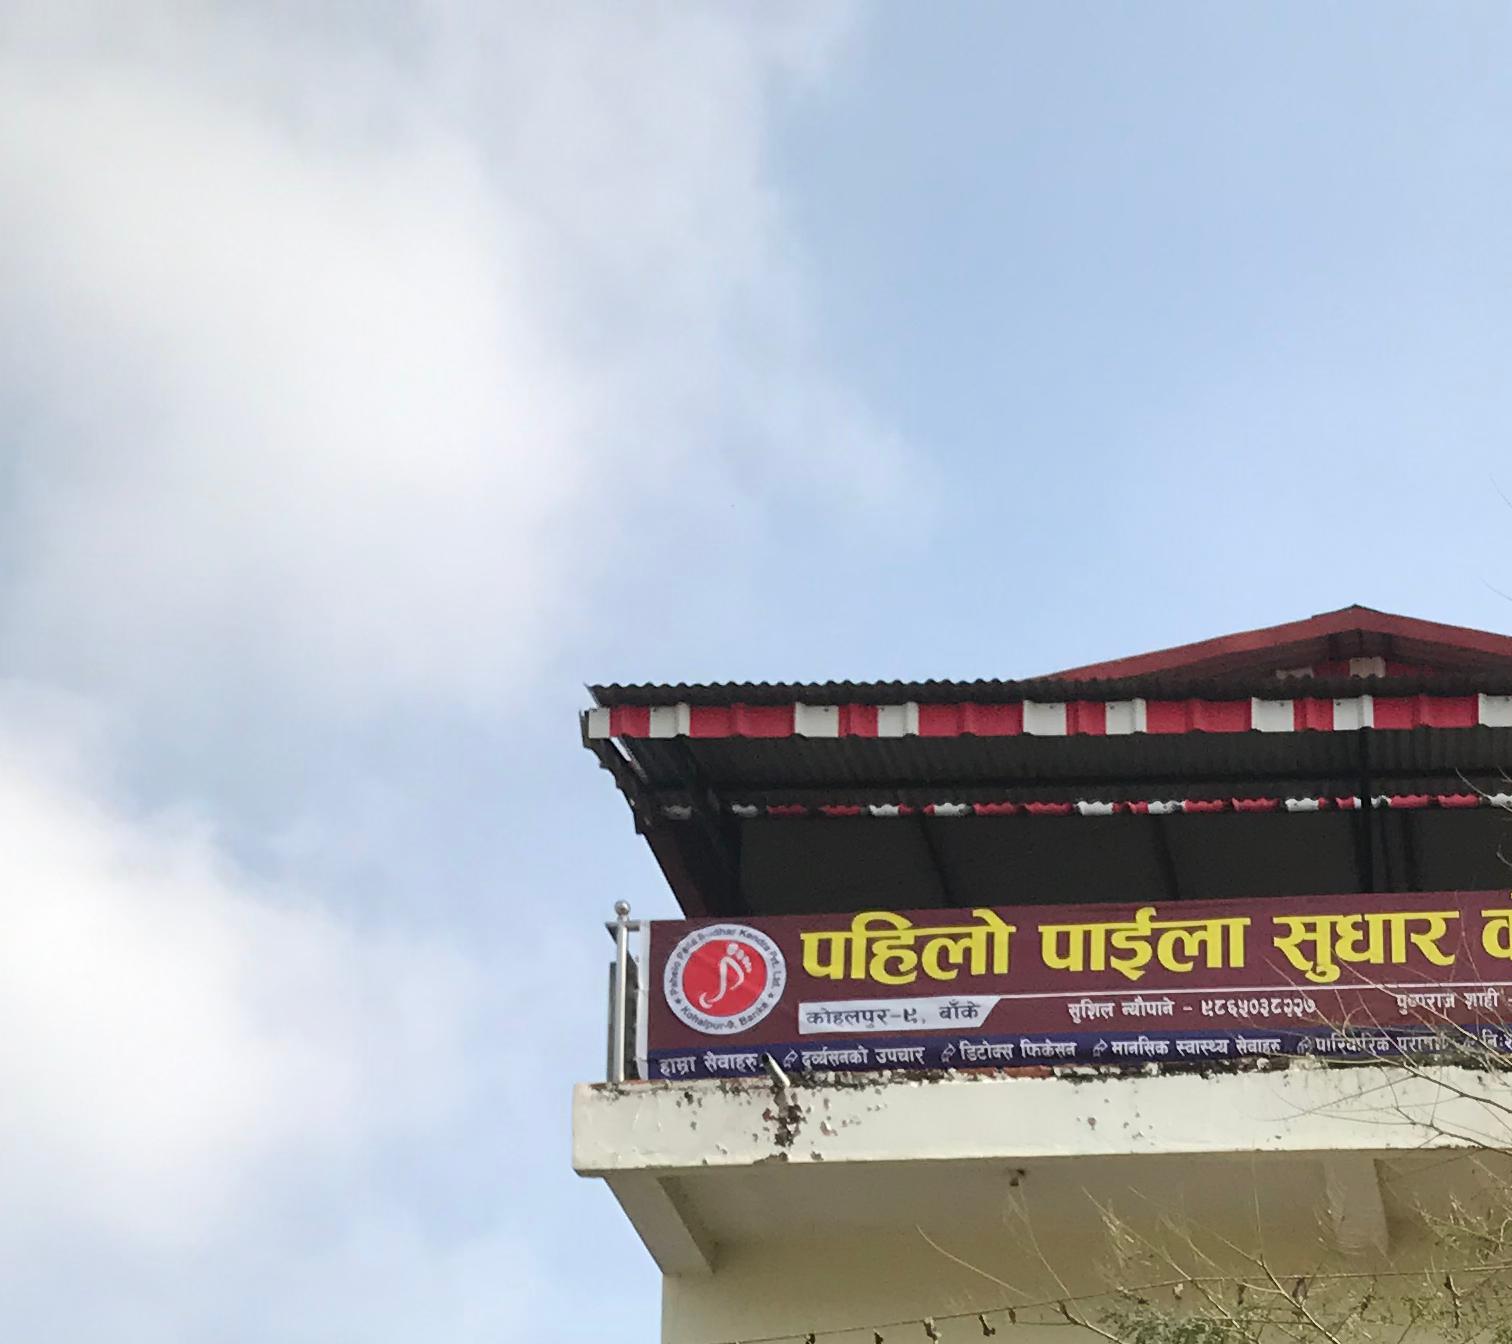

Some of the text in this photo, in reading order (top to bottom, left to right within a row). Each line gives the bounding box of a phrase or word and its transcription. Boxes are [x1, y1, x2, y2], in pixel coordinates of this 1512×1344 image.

[800, 908, 1016, 984] पहिलो
[1038, 907, 1250, 981] पाईला
[1274, 909, 1459, 984] सुधार
[1068, 998, 1115, 1024] सुशिल
[659, 1056, 696, 1076] हाम्रा
[875, 1046, 926, 1066] उपचार
[1111, 1036, 1170, 1057] मानसिक
